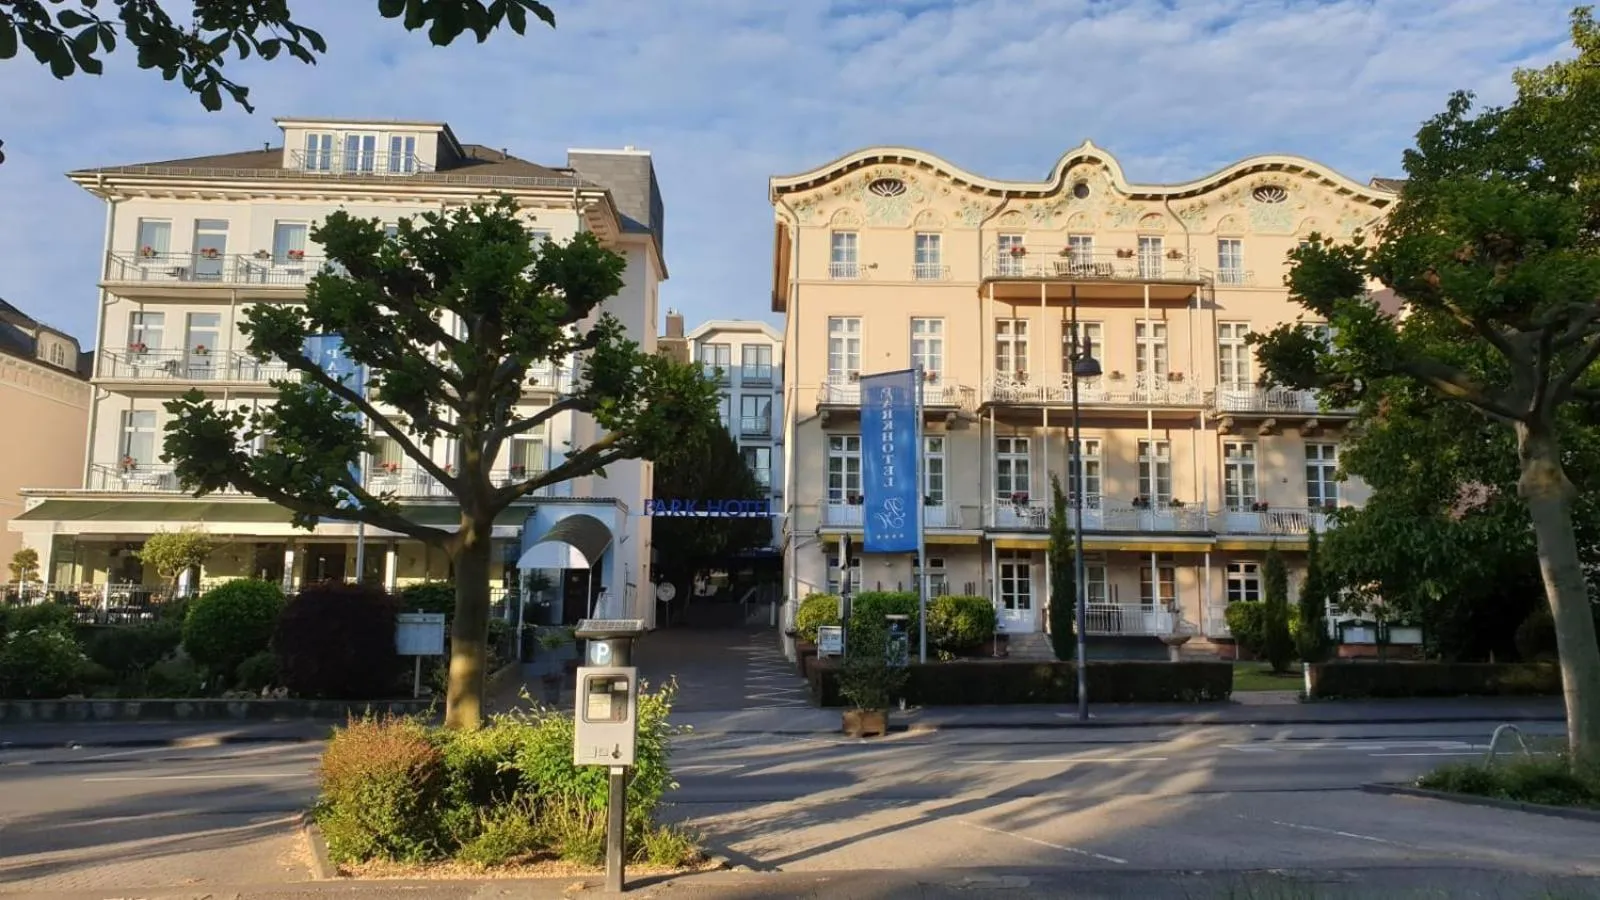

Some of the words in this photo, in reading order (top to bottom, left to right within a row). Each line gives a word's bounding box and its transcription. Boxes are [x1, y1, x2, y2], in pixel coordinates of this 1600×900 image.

[644, 498, 697, 516] PARK
[708, 498, 776, 517] HOTEL
[596, 642, 610, 665] P
